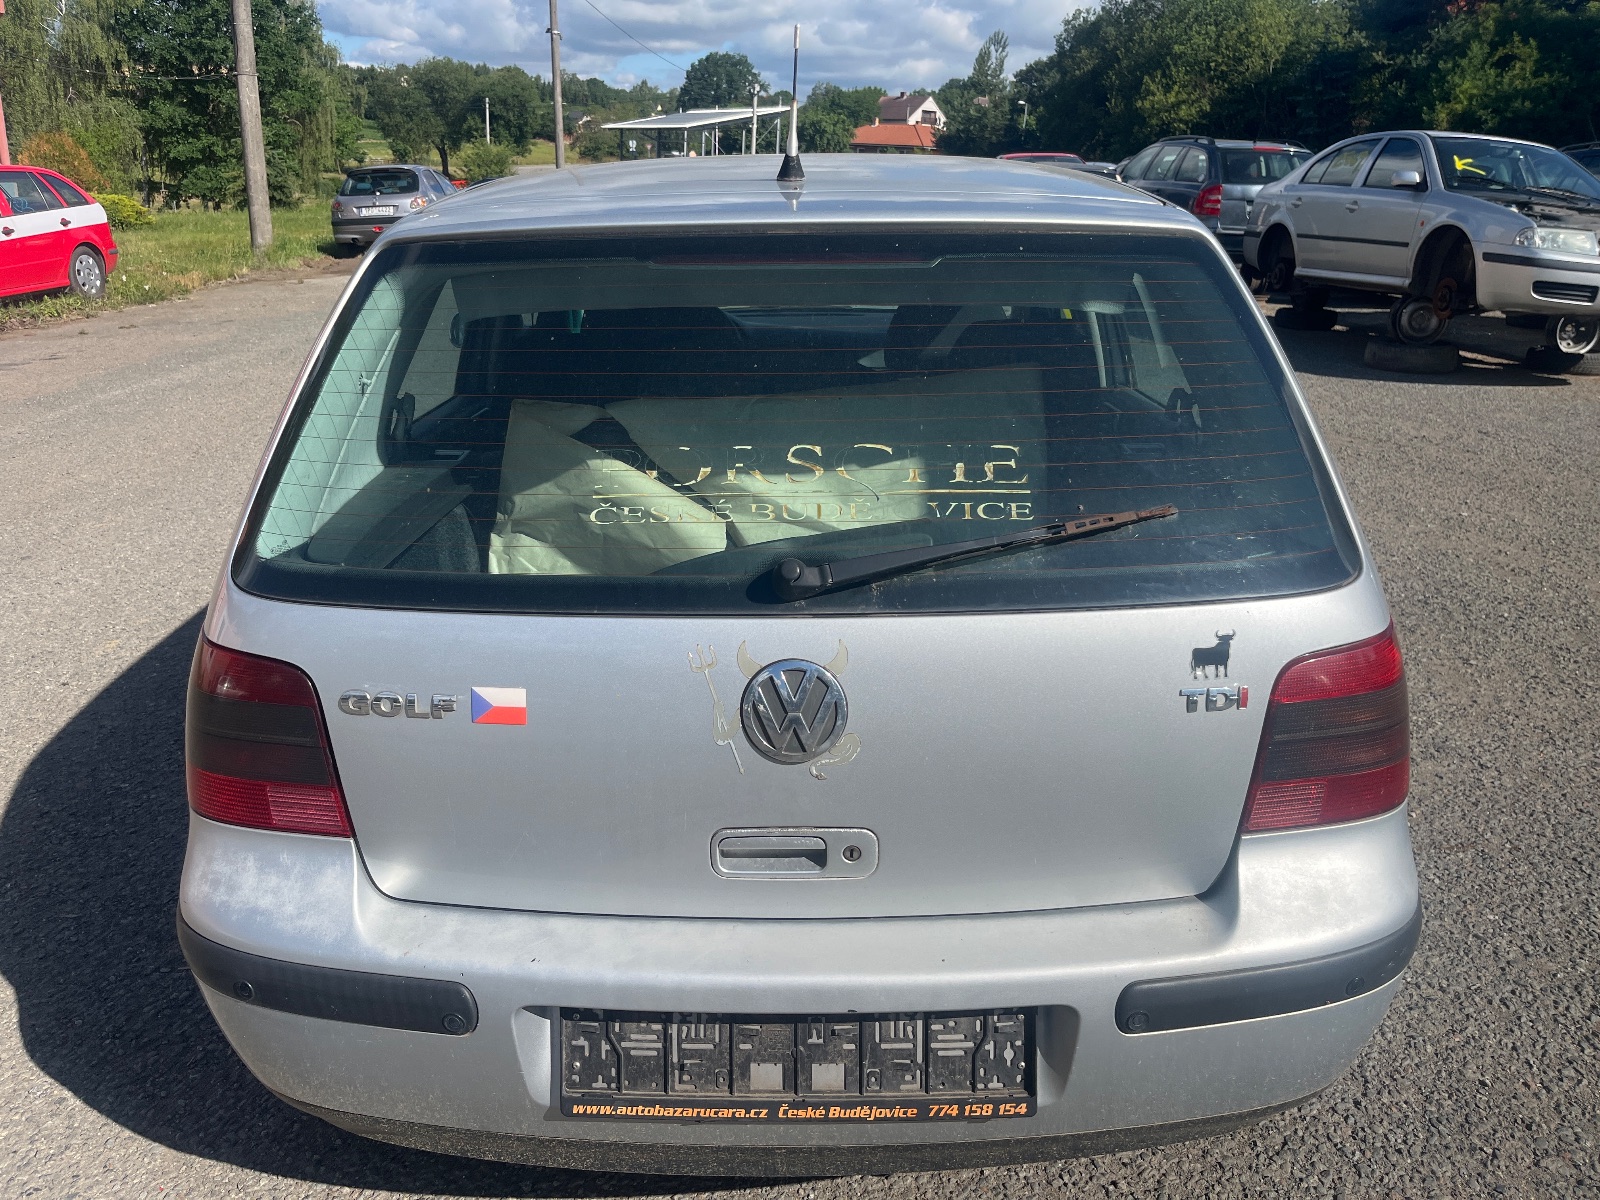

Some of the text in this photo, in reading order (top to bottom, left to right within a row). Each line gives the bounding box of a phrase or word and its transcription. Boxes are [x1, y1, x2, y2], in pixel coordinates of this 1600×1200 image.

[749, 498, 1035, 522] BUDĚVICE
[338, 689, 457, 720] GOLF
[1179, 685, 1249, 713] TDI
[572, 1103, 1028, 1121] www.autobazarucara.cz České Budějovice 774 158 154
